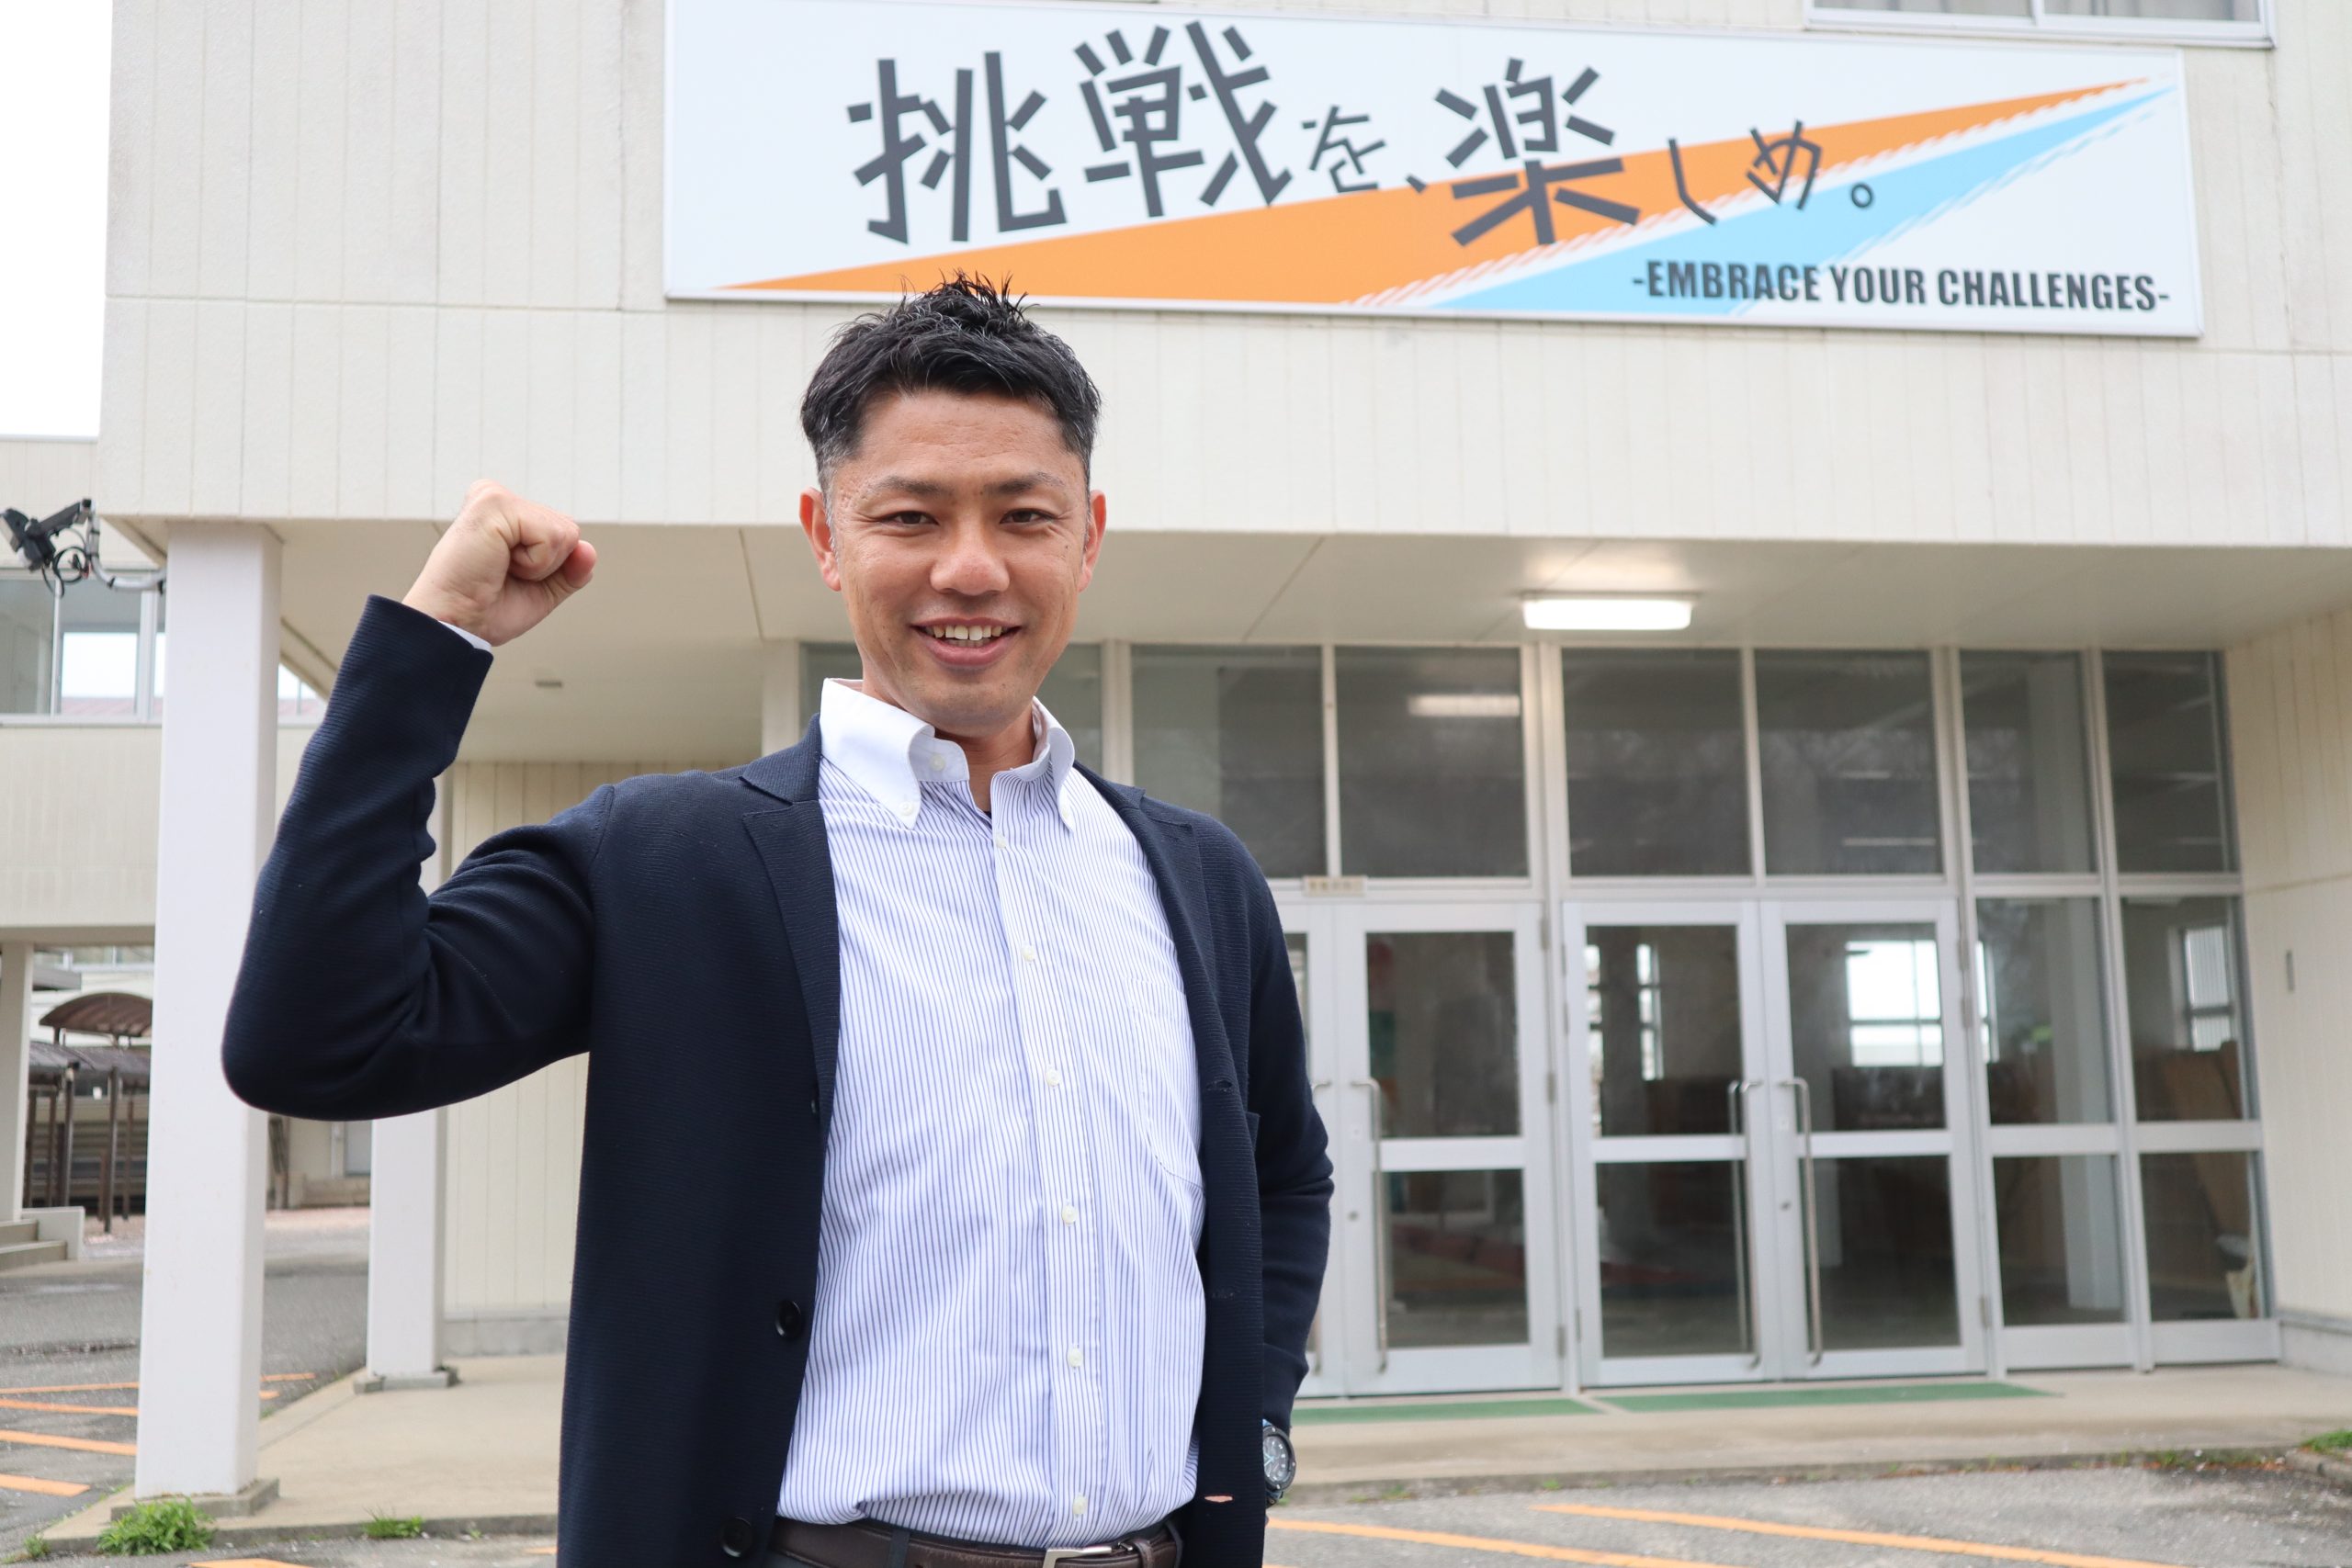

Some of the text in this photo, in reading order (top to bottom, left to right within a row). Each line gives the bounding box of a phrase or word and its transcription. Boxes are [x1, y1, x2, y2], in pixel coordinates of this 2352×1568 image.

[847, 21, 1874, 247] 挑戦を、楽しめ。
[1633, 260, 2170, 311] -EMBRACE YOUR CHALLENGES-
